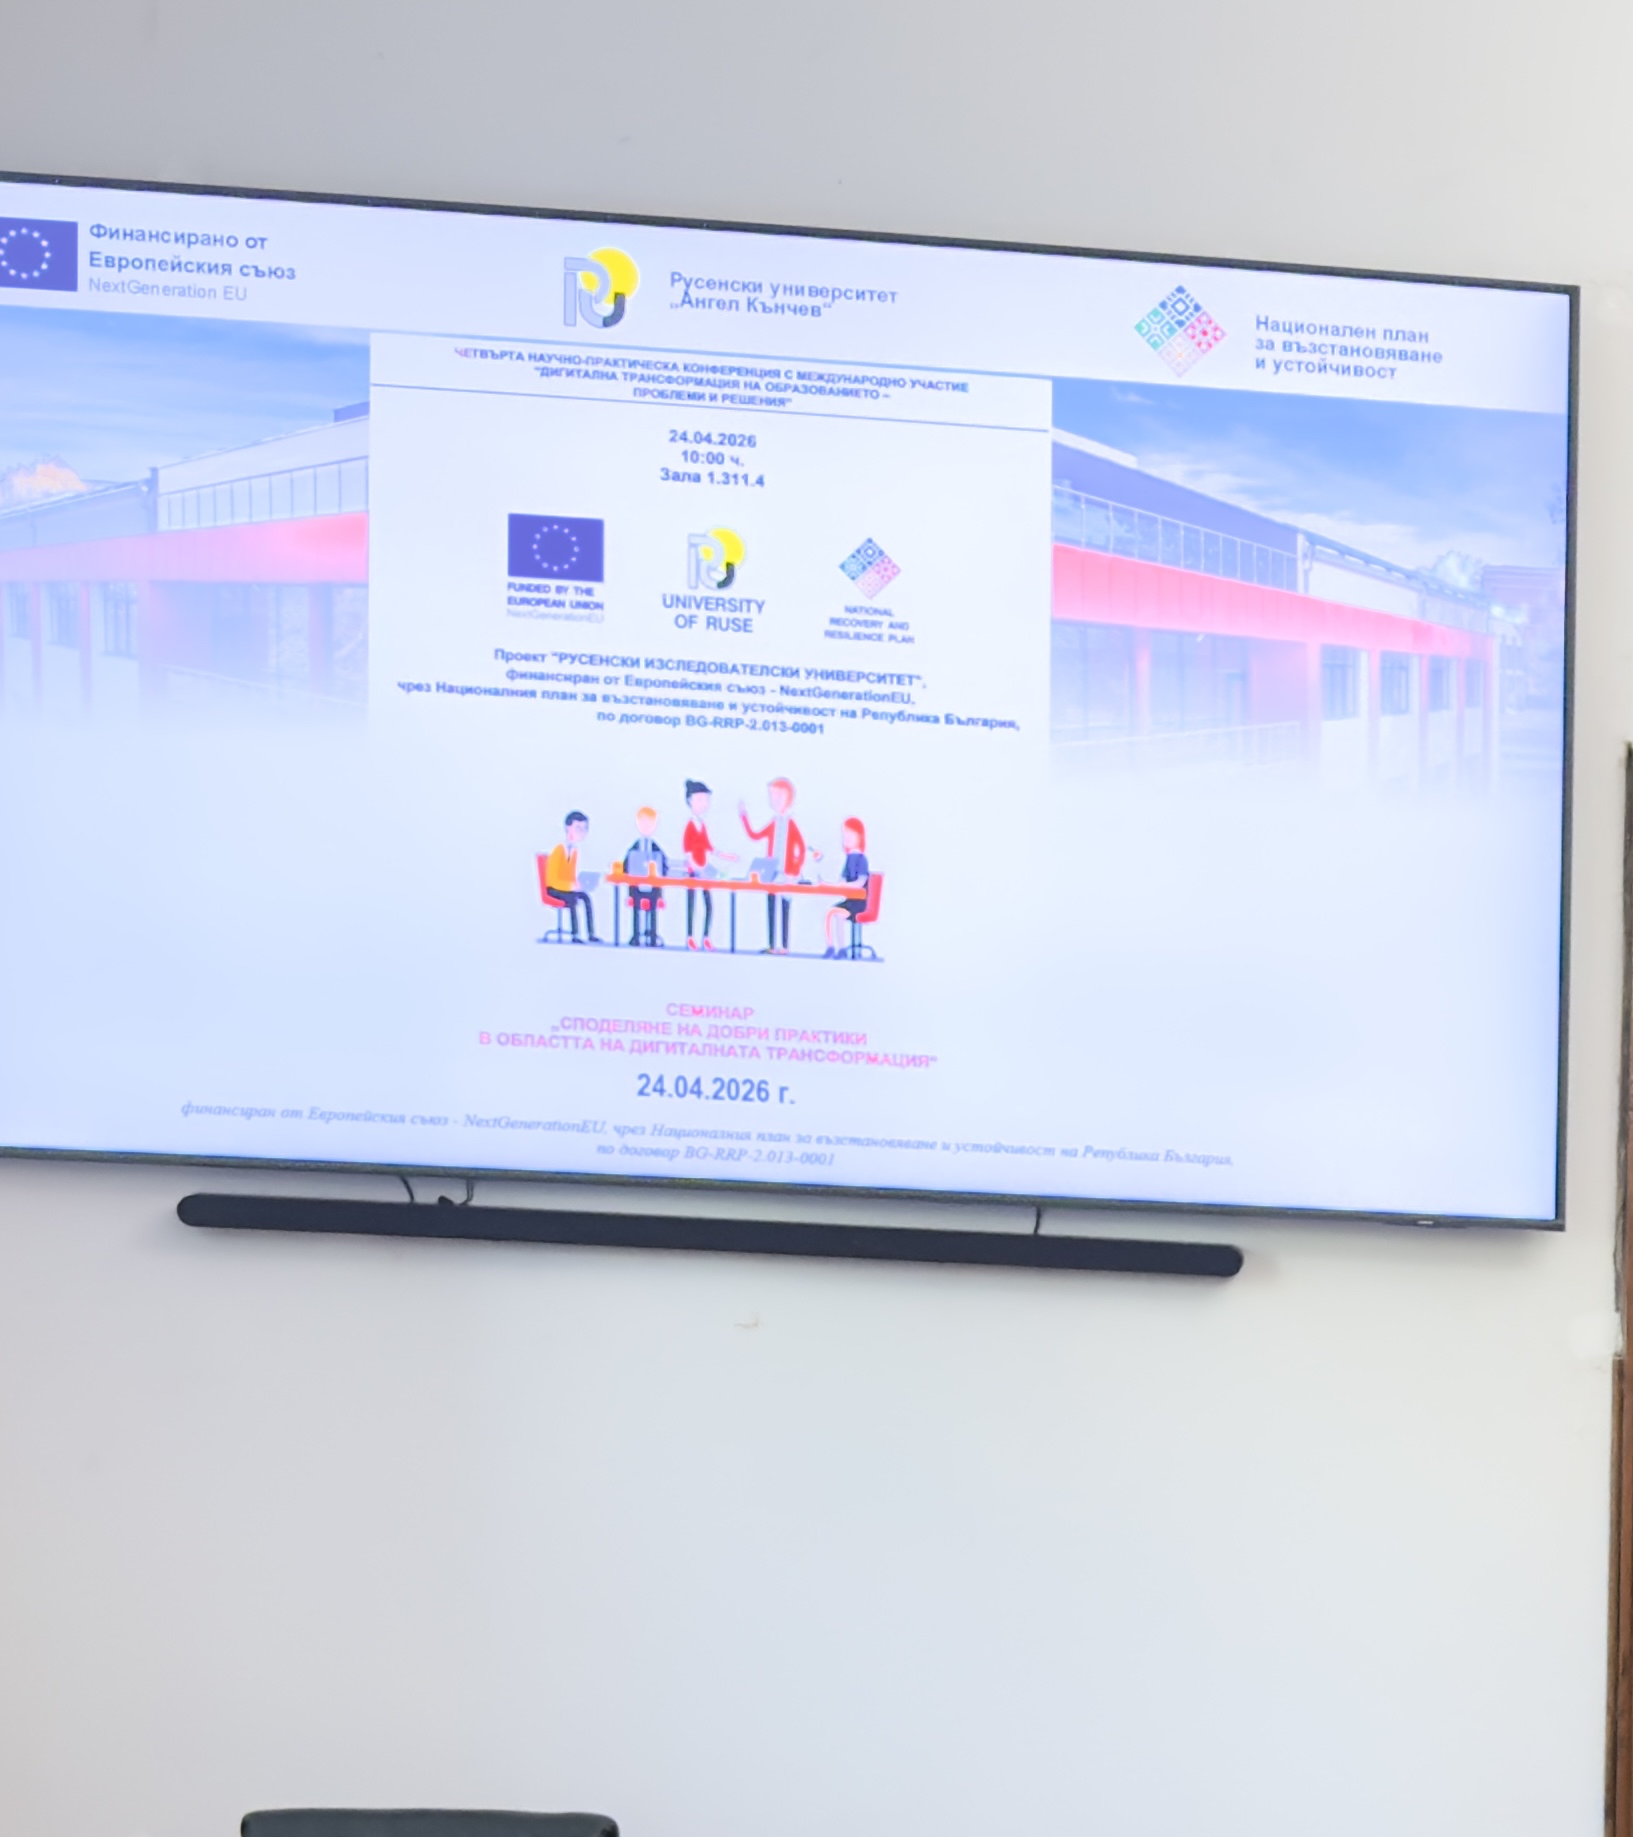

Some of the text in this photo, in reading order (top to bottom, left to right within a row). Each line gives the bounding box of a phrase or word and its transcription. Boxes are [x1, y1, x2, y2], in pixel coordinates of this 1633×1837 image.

[89, 223, 268, 250] Финансирано от
[89, 250, 296, 280] Европейския съюз
[670, 271, 897, 307] Русенски университет
[1256, 315, 1428, 343] Национален план
[1256, 338, 1442, 363] за възстановяване
[1256, 357, 1396, 379] и устойчивост
[669, 429, 756, 448] 24.04.2026
[660, 467, 765, 487] Зала 1.311.4
[662, 593, 765, 614] UNIVERSITY
[674, 614, 753, 633] OF RUSE
[506, 668, 600, 685] финансиран
[603, 675, 620, 686] от
[624, 674, 722, 692] Европейския
[726, 683, 766, 696] съюз
[397, 681, 431, 693] чрез
[436, 681, 537, 698] Националния
[541, 690, 577, 701] план
[582, 692, 597, 703] за
[602, 694, 724, 711] възстановяване
[728, 702, 738, 711] и
[742, 703, 836, 717] устойчивост
[840, 709, 857, 719] на
[861, 708, 940, 725] Република
[597, 712, 824, 735] по договор BG-RRP-2.013-0001
[666, 1003, 754, 1020] СЕМИНАР
[480, 1032, 491, 1045] В
[497, 1032, 595, 1050] ОБЛАСТТА
[600, 1037, 624, 1052] НА
[629, 1039, 760, 1059] ДИГИТАЛНАТА
[678, 1022, 702, 1037] НА
[706, 1024, 769, 1040] ДОБРИ
[775, 1028, 867, 1045] ПРАКТИКИ
[637, 1073, 795, 1104] 24.04.2026 г.
